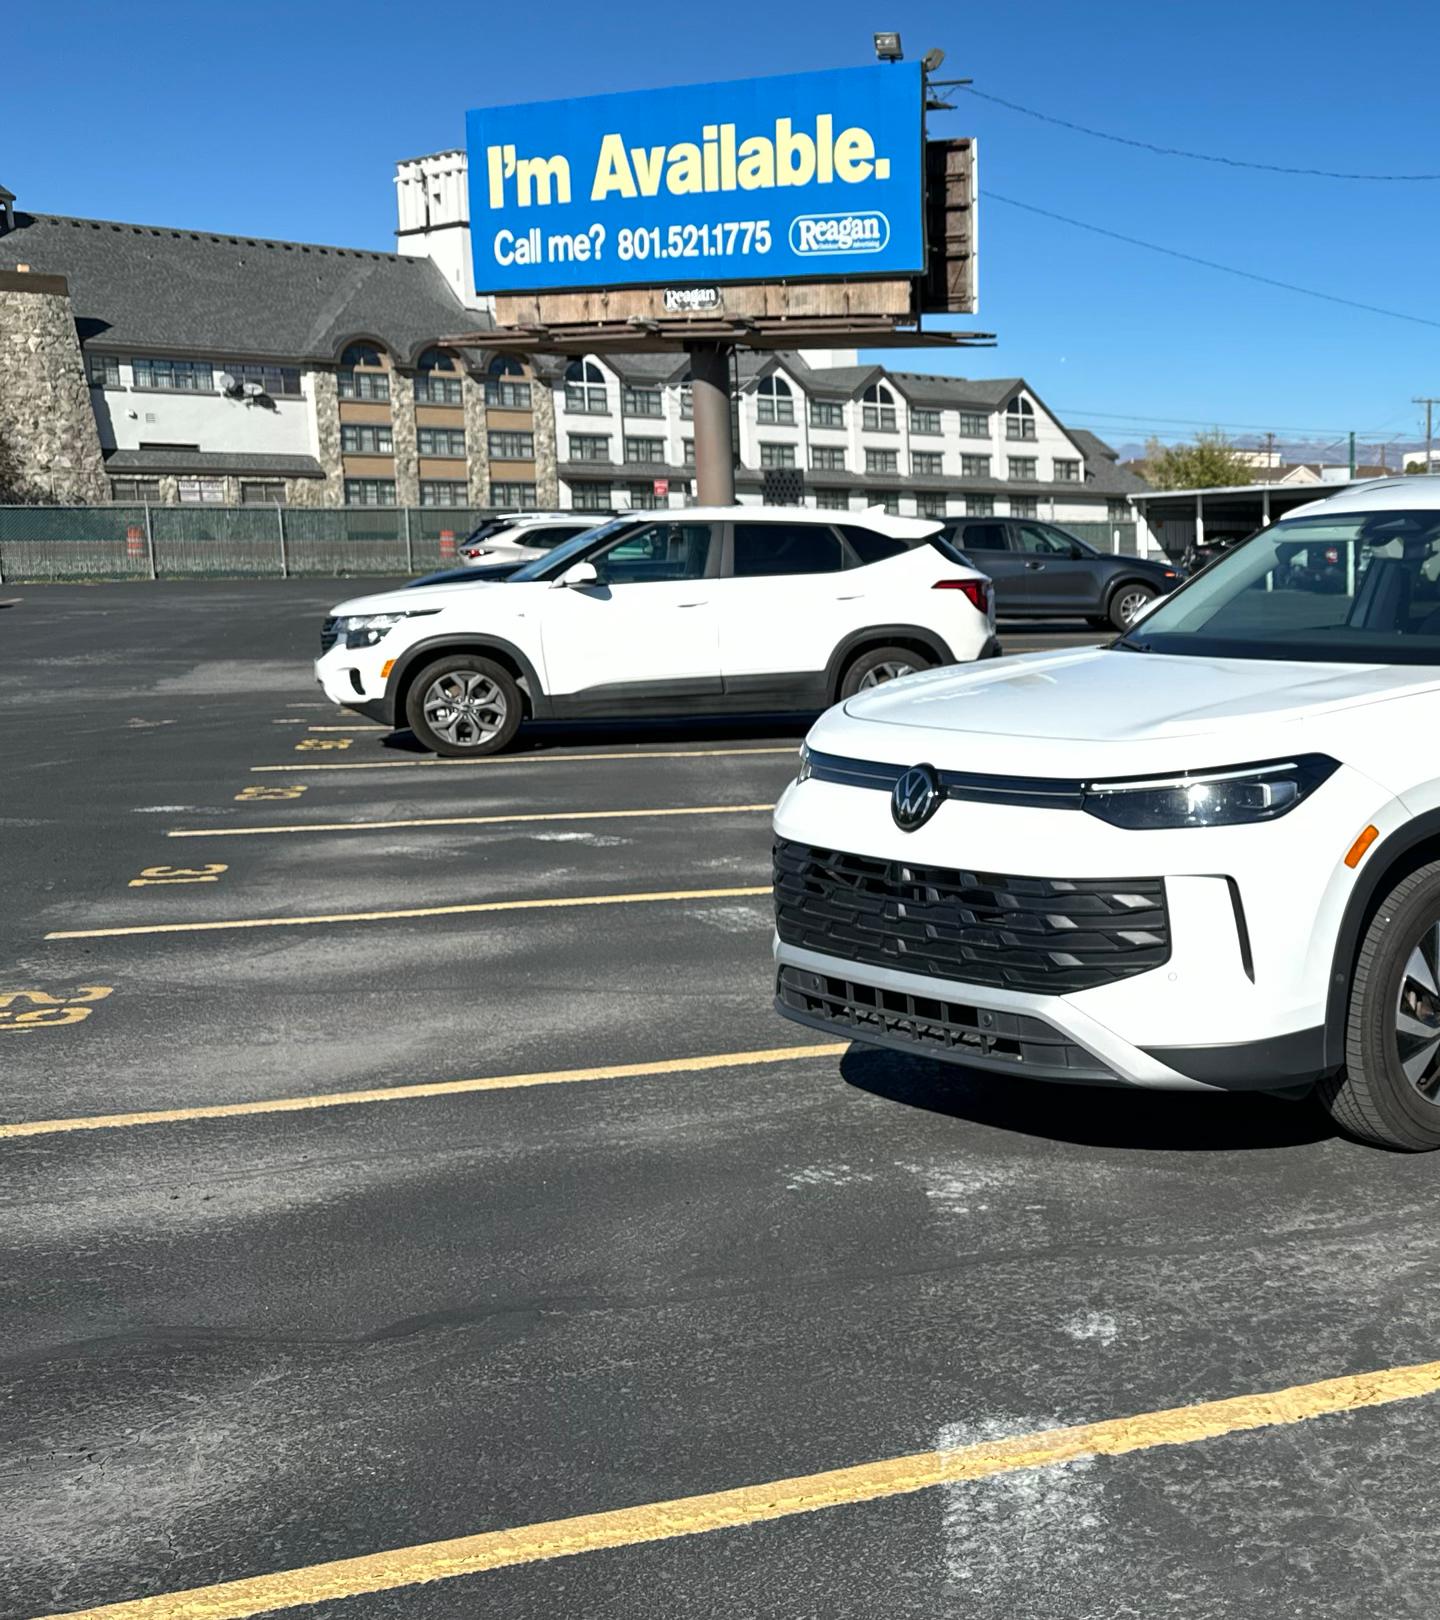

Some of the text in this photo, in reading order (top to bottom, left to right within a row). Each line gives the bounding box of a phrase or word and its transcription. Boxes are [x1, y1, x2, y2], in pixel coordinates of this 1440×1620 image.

[487, 113, 891, 209] I'm Available.
[494, 220, 772, 266] Call me? 801.521.1775
[798, 216, 881, 252] Reagan
[666, 288, 716, 310] Reagan
[127, 863, 229, 888] 31
